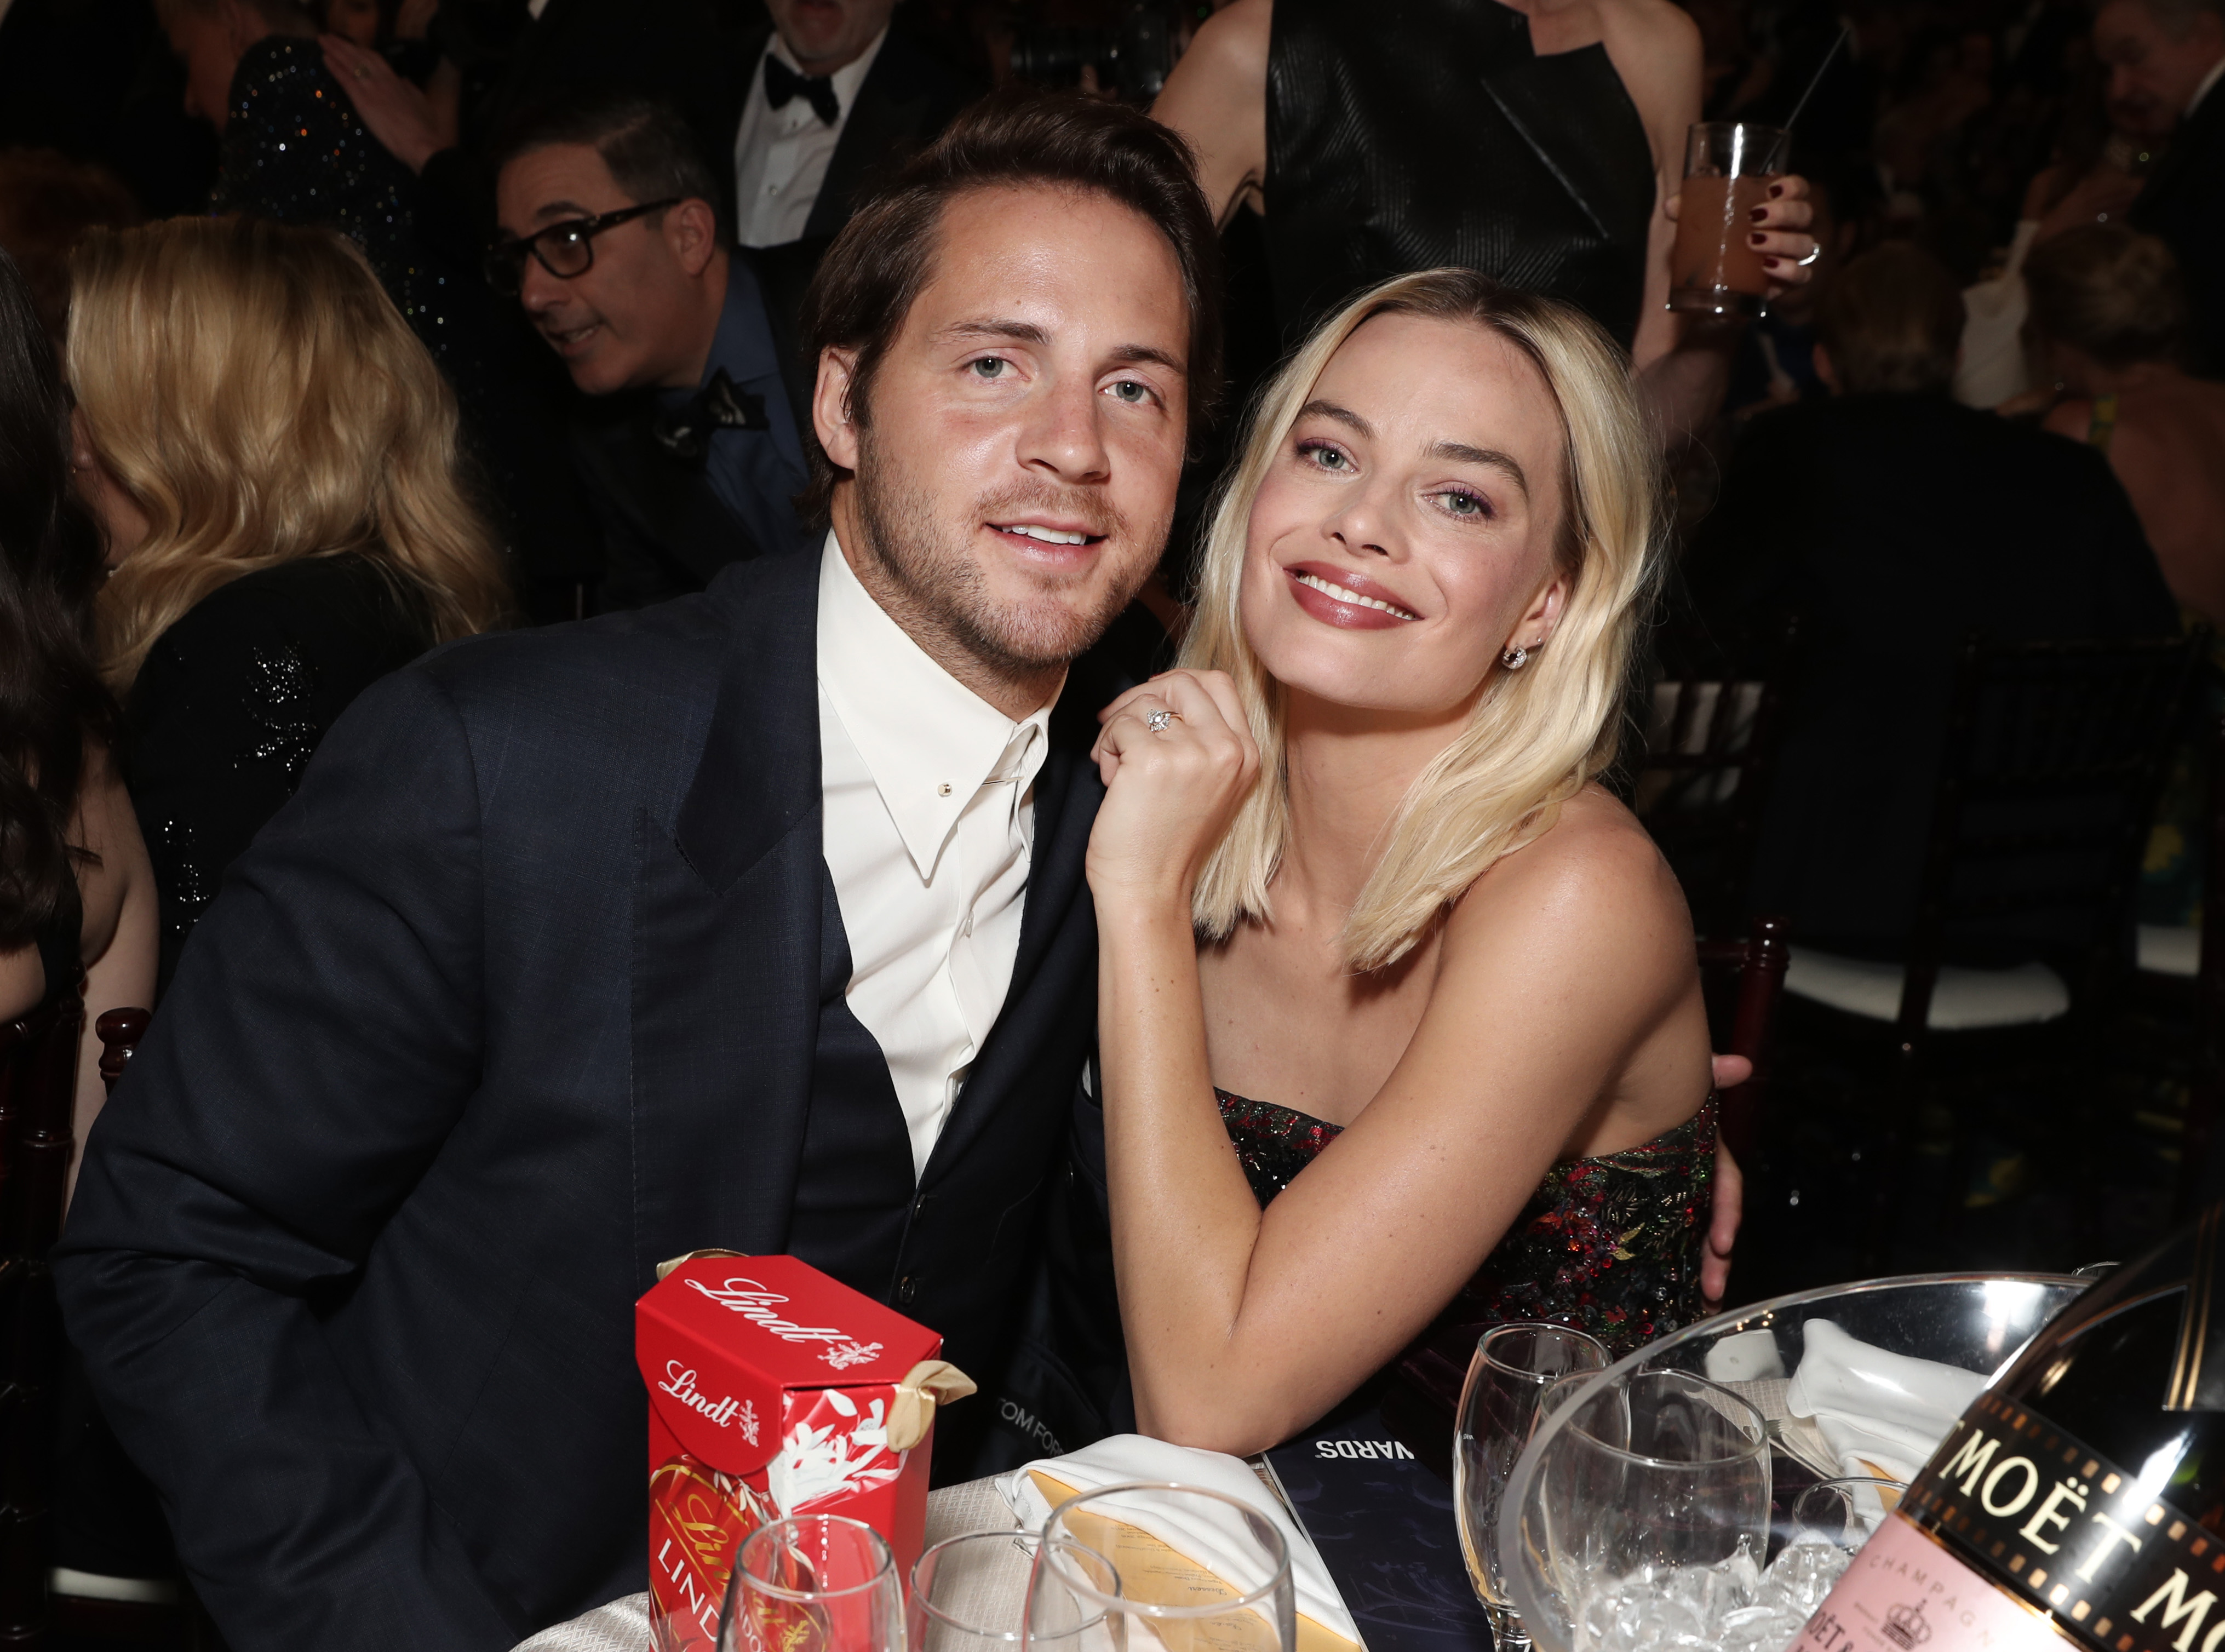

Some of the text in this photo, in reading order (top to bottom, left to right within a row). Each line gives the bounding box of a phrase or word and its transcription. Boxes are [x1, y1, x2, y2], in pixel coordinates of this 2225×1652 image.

[685, 1277, 852, 1345] Lindt
[658, 1360, 740, 1429] Lindt
[1939, 1428, 2142, 1584] MOËT
